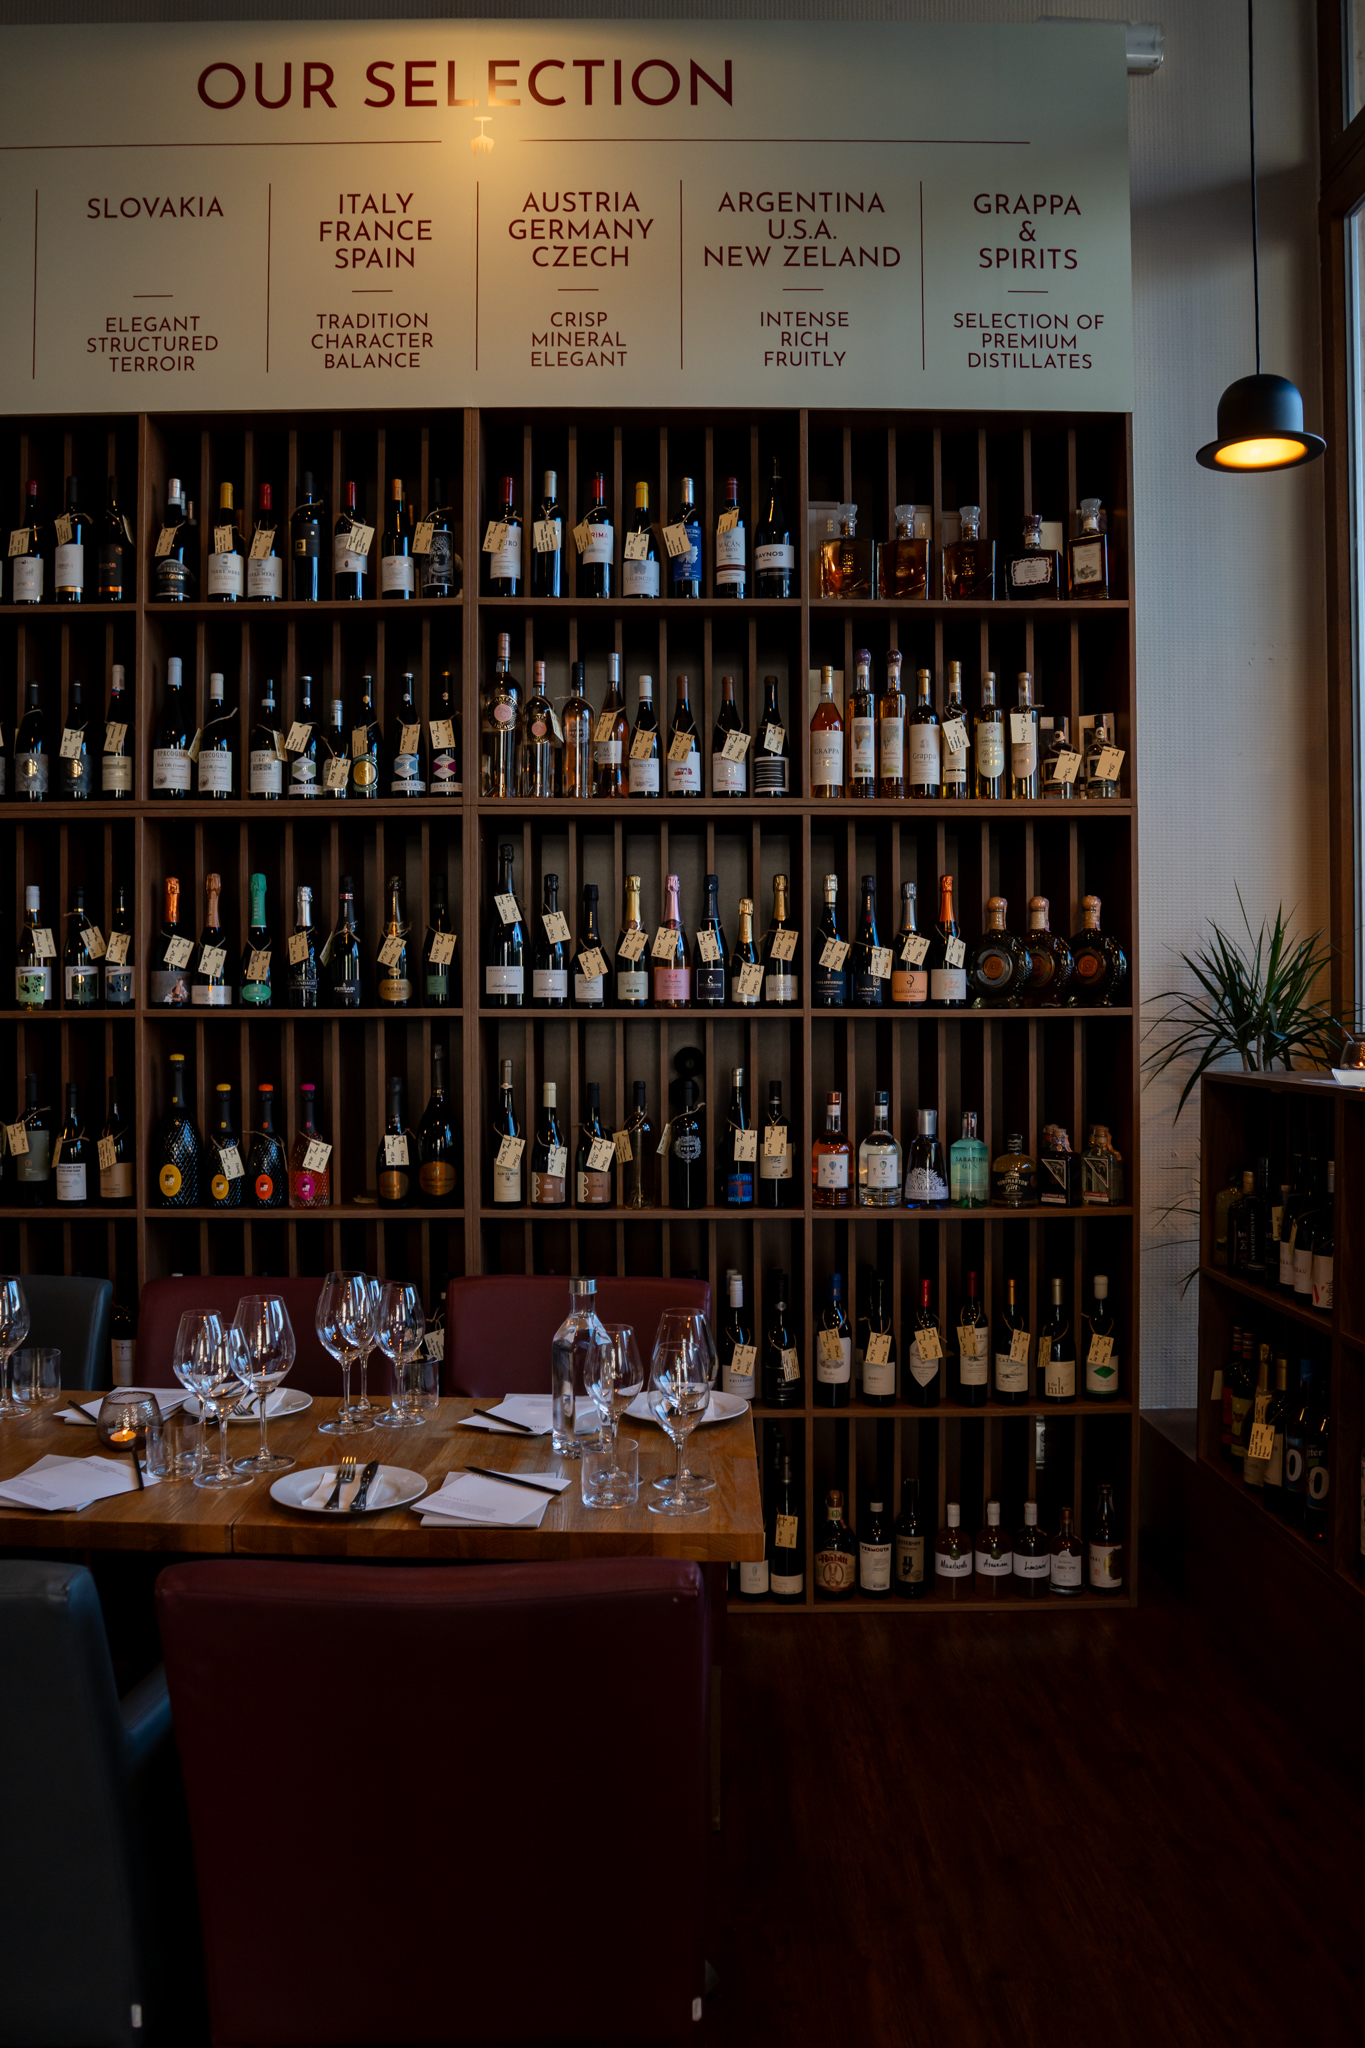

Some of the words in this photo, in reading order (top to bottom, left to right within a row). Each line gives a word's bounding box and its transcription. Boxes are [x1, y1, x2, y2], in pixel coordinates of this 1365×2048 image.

[198, 62, 337, 109] OUR
[364, 59, 732, 108] SELECTION
[87, 197, 224, 219] SLOVAKIA
[340, 193, 413, 214] ITALY
[522, 192, 640, 212] AUSTRIA
[718, 192, 885, 212] ARGENTINA
[974, 194, 1081, 215] GRAPPA
[320, 220, 432, 241] FRANCE
[509, 219, 653, 239] GERMANY
[769, 219, 836, 239] U.S.A.
[1019, 220, 1036, 241] &
[335, 247, 414, 268] SPAIN
[533, 246, 628, 267] CZECH
[705, 246, 771, 266] NEW
[783, 245, 900, 267] ZELAND
[979, 248, 1077, 269] SPIRITS
[106, 316, 200, 332] ELEGANT
[317, 313, 427, 329] TRADITION
[551, 312, 607, 327] CRISP
[761, 312, 849, 326] INTENSE
[954, 313, 1068, 329] SELECTION
[1077, 315, 1104, 329] OF
[87, 336, 218, 353] STRUCTURED
[312, 333, 433, 349] CHARACTER
[533, 332, 626, 346] MINERAL
[782, 331, 828, 346] RICH
[983, 333, 1076, 349] PREMIUM
[109, 356, 194, 372] TERROIR
[325, 353, 420, 368] BALANCE
[532, 352, 627, 366] ELEGANT
[765, 351, 846, 366] FRUITLY
[969, 353, 1092, 369] DISTILLATES
[912, 753, 936, 761] Grappa
[1047, 1377, 1065, 1394] hilt
